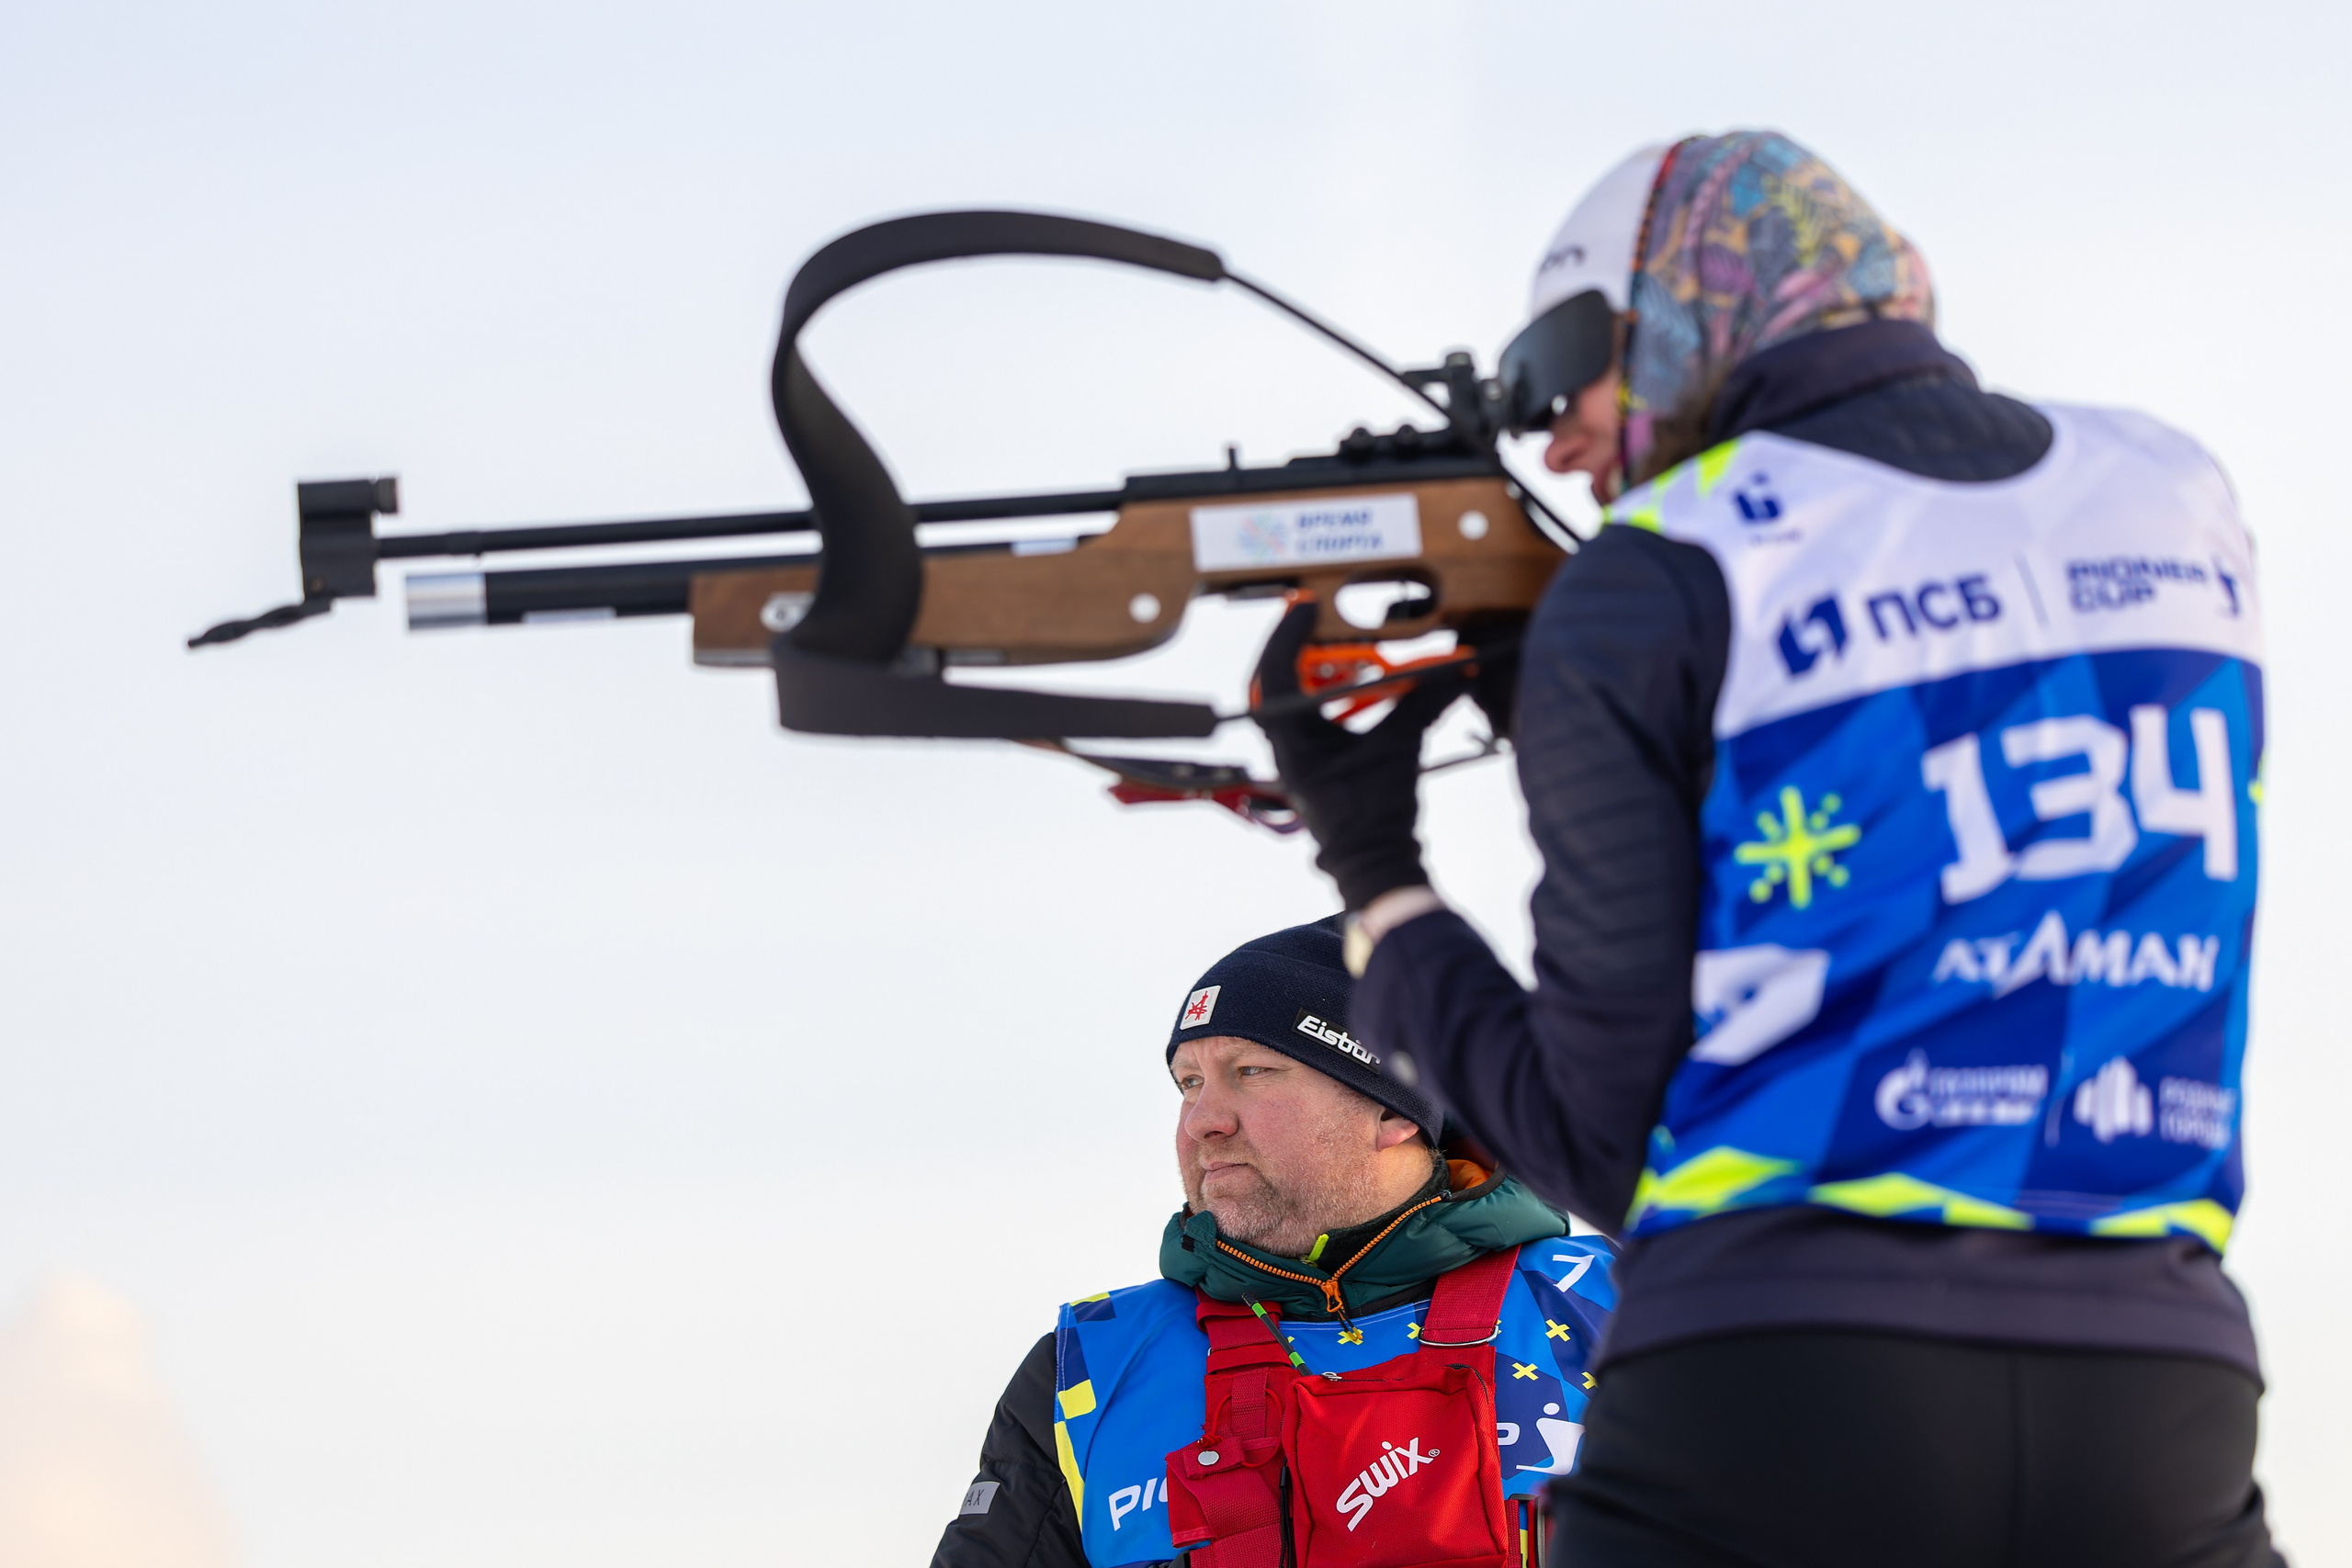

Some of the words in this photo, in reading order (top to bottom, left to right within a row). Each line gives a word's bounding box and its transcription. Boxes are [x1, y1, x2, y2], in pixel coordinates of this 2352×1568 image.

[1864, 570, 2003, 643] ПСБ
[1920, 704, 2239, 906] 134
[962, 1489, 985, 1506] AX
